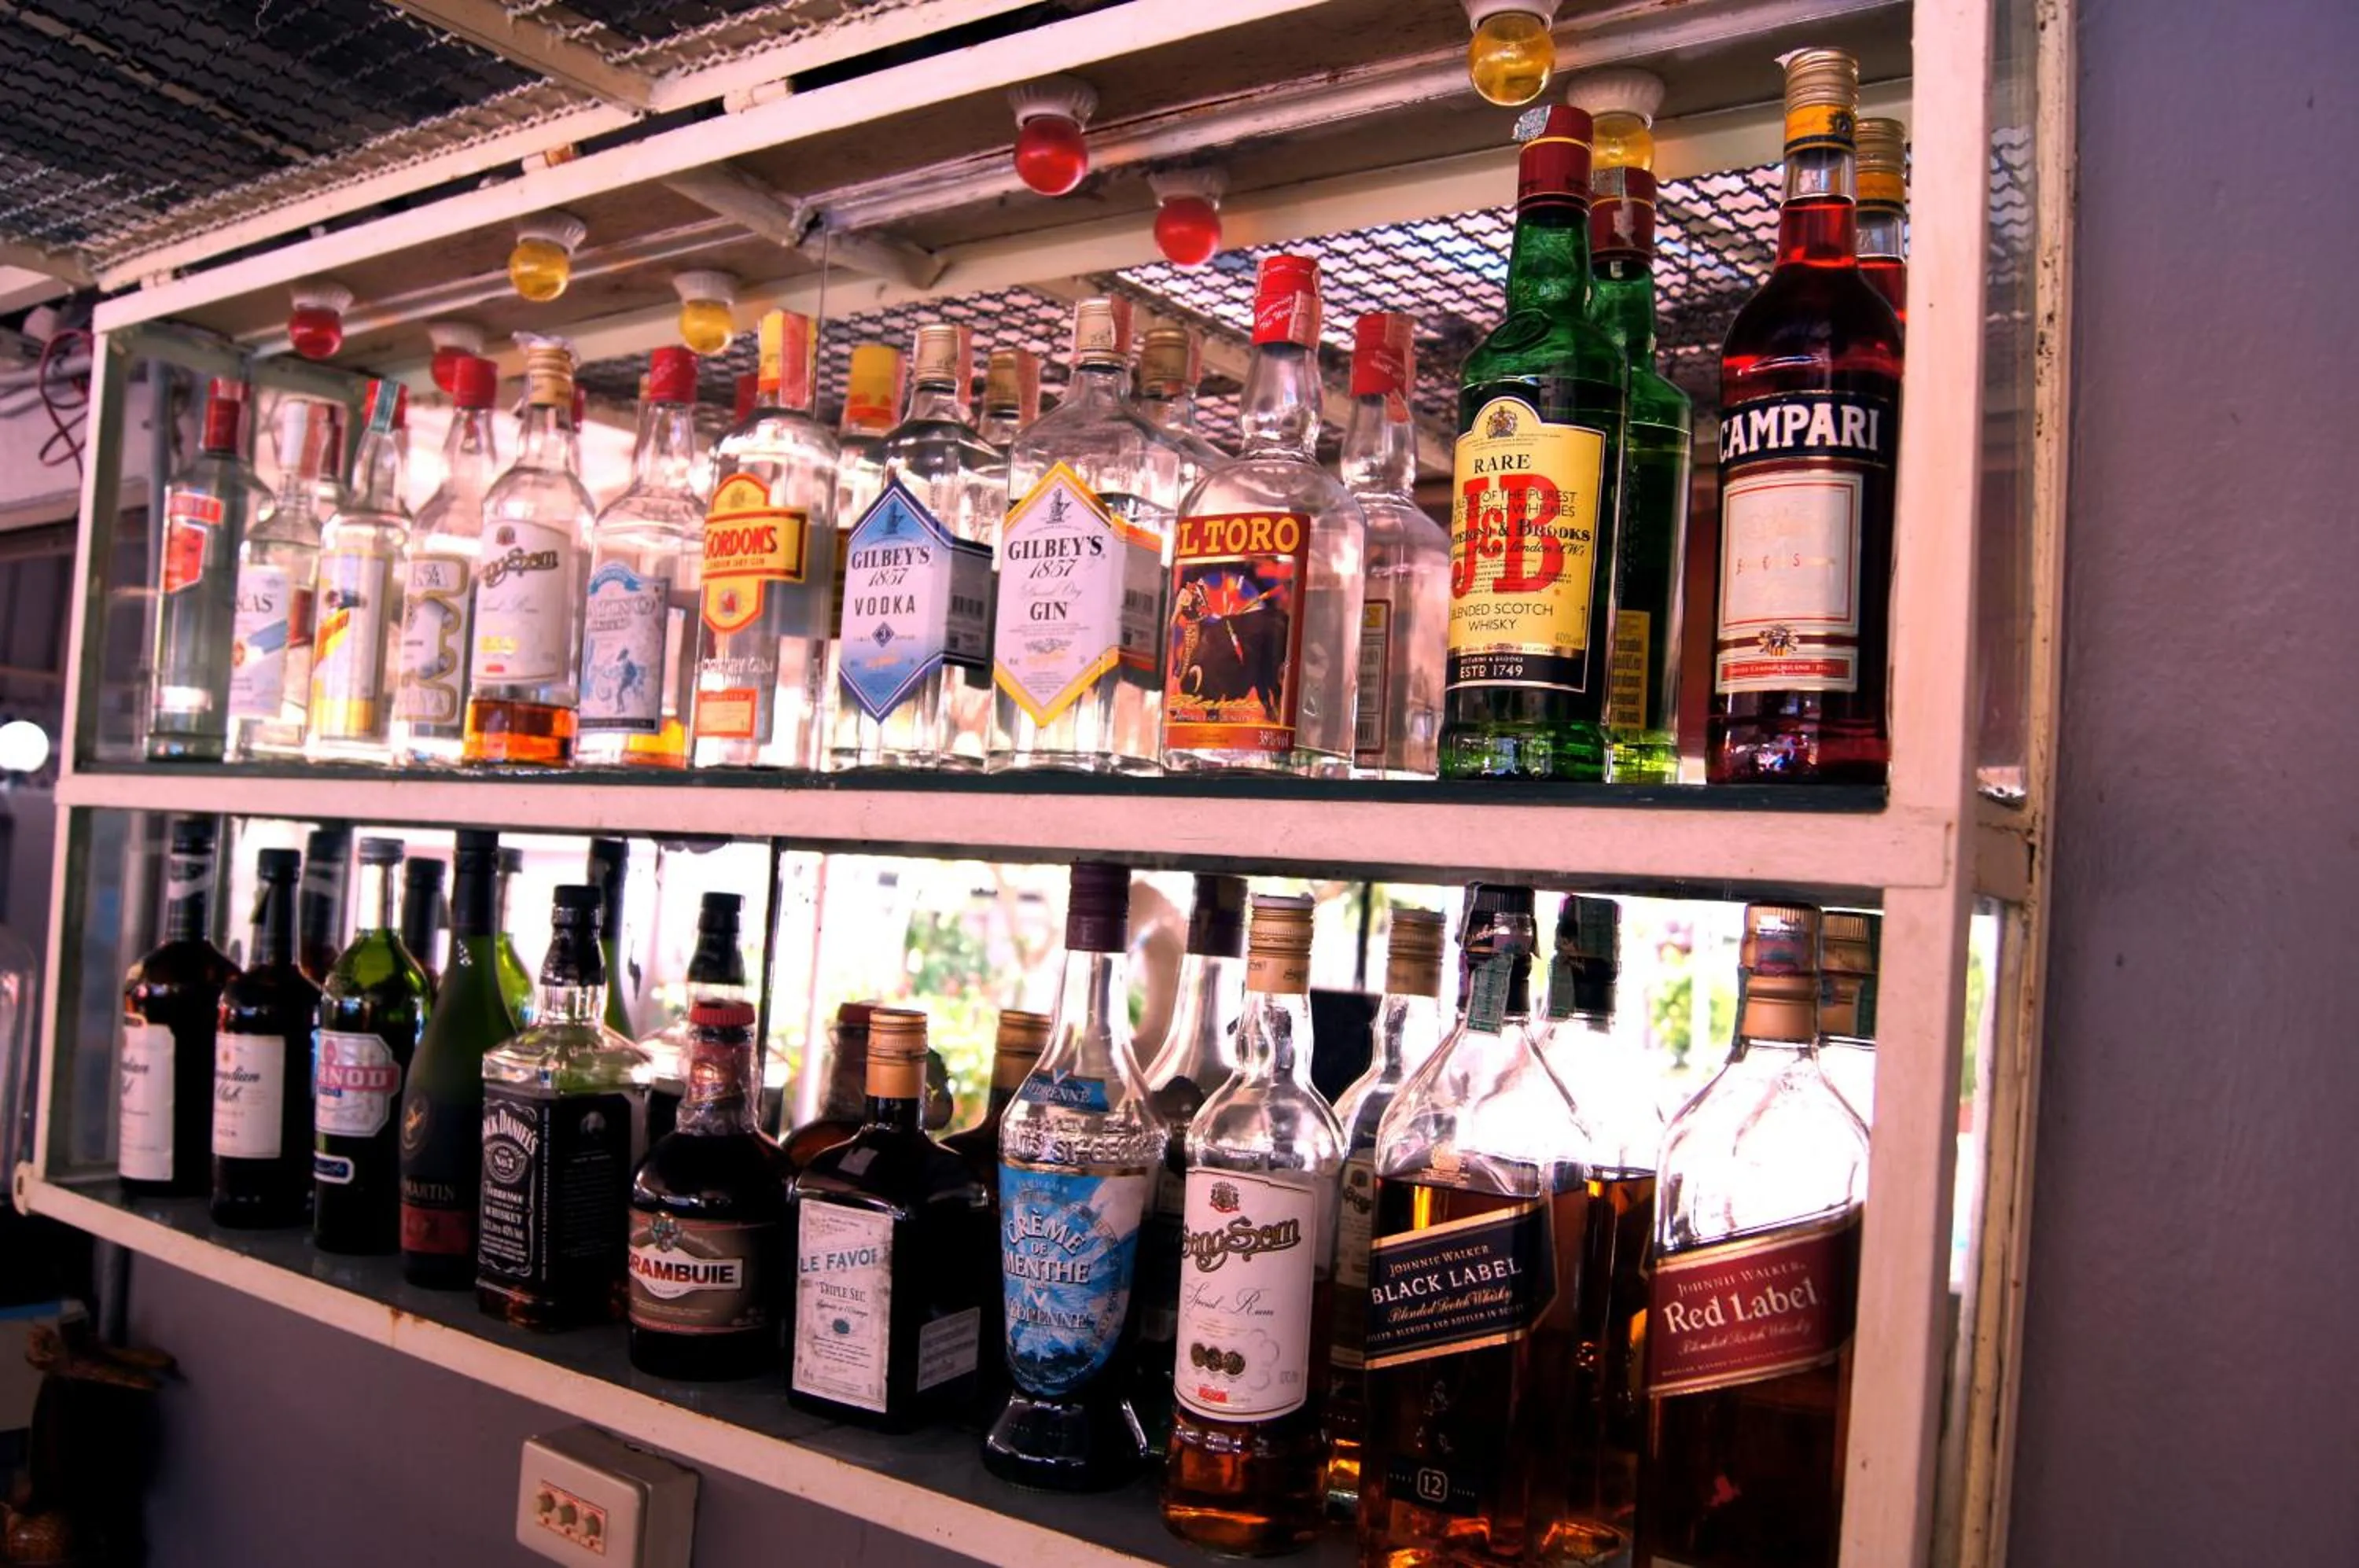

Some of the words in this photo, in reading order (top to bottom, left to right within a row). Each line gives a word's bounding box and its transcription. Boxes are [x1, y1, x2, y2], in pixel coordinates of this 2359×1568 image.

[1720, 403, 1879, 464] CAMPARI
[1474, 454, 1531, 473] RARE
[1481, 490, 1498, 502] OF
[1500, 489, 1527, 501] THE
[1528, 489, 1578, 502] PUREST
[1177, 523, 1198, 555] L
[1204, 517, 1300, 553] TORO
[1499, 521, 1510, 537] &
[852, 547, 930, 569] GILBEY'S
[1008, 536, 1103, 560] GILBEY'S
[868, 568, 909, 587] 1857
[1029, 559, 1077, 578] 1857
[855, 595, 915, 617] VODKA
[1030, 602, 1068, 620] GIN
[1494, 602, 1554, 617] SCOTCH
[1468, 618, 1518, 631] WHISKY
[1493, 664, 1523, 678] 1749
[1032, 1242, 1048, 1255] DE
[629, 1253, 734, 1284] RAMBUIE
[800, 1256, 820, 1273] LE
[1005, 1250, 1091, 1284] MENTHE
[1389, 1257, 1440, 1278] JOHNNIE
[1441, 1245, 1490, 1263] WALKER
[1371, 1275, 1443, 1305] BLACK
[1448, 1257, 1522, 1287] LABEL
[1677, 1275, 1736, 1297] JOHNNIE
[1739, 1262, 1799, 1282] WALKER
[1221, 1287, 1274, 1316] Rum
[1662, 1294, 1726, 1334] Red
[1729, 1275, 1818, 1322] Label
[1424, 1475, 1441, 1496] 12
